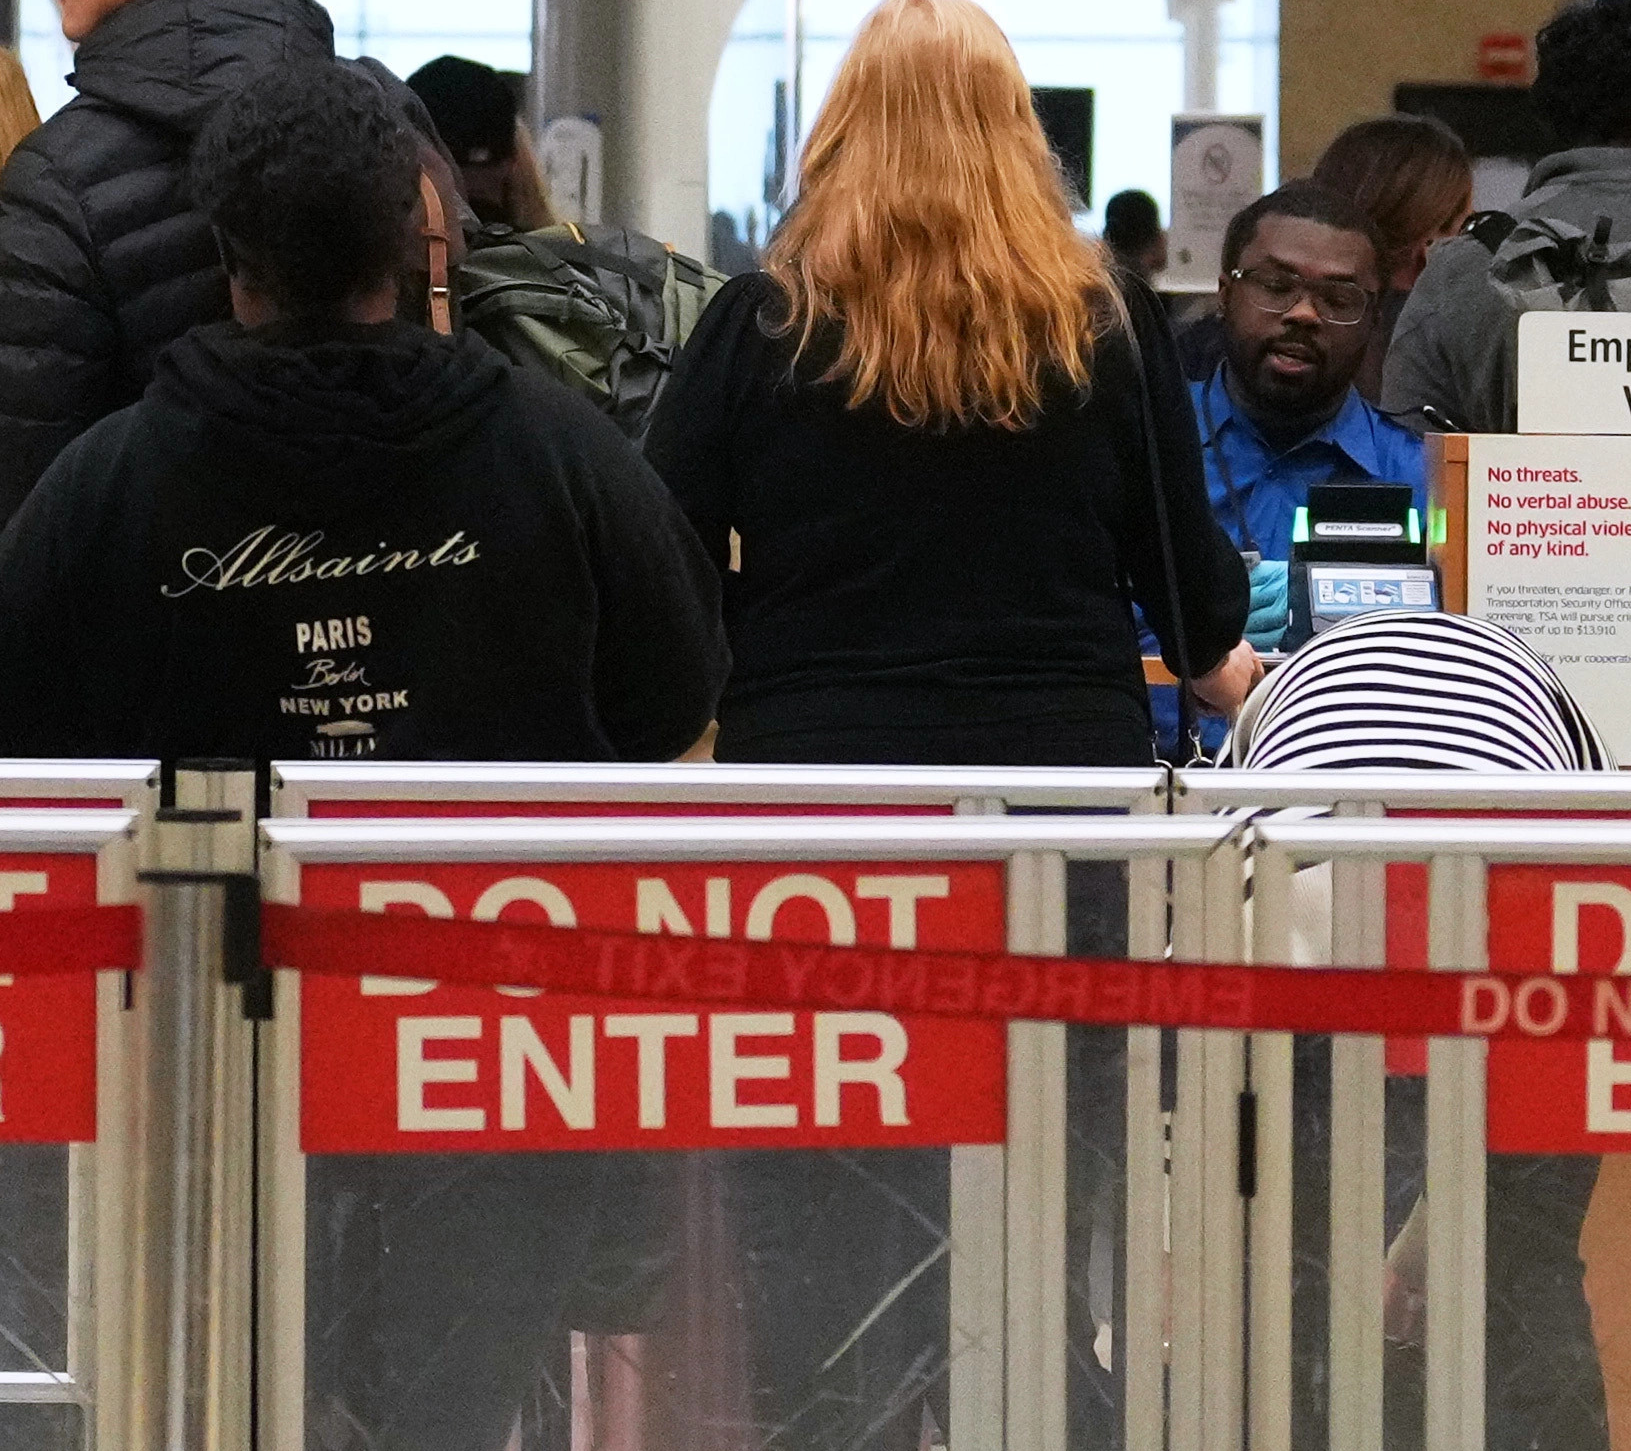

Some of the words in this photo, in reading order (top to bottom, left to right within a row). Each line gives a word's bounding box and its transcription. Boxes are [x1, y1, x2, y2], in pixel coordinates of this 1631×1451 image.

[1488, 467, 1512, 482] No
[1517, 467, 1582, 483] threats.
[1488, 494, 1512, 509] No
[1517, 494, 1571, 509] verbal
[1577, 494, 1631, 510] abuse.
[1488, 520, 1511, 535] No
[1516, 520, 1586, 538] physical
[1487, 540, 1505, 556] of
[1510, 543, 1541, 558] any
[1547, 541, 1589, 556] kind.
[161, 525, 481, 599] Allsaints
[1496, 587, 1515, 597] you
[1615, 588, 1625, 596] or
[1487, 598, 1558, 610] Transportation
[1561, 598, 1601, 611] Security
[1538, 612, 1557, 622] TSA
[1561, 612, 1577, 622] will
[1580, 614, 1614, 625] pursue
[296, 615, 373, 654] PARIS
[1535, 625, 1545, 635] of
[1548, 627, 1561, 638] up
[279, 697, 331, 716] NEW
[339, 689, 409, 715] YORK
[1461, 979, 1569, 1036] DO
[396, 1011, 912, 1132] ENTER
